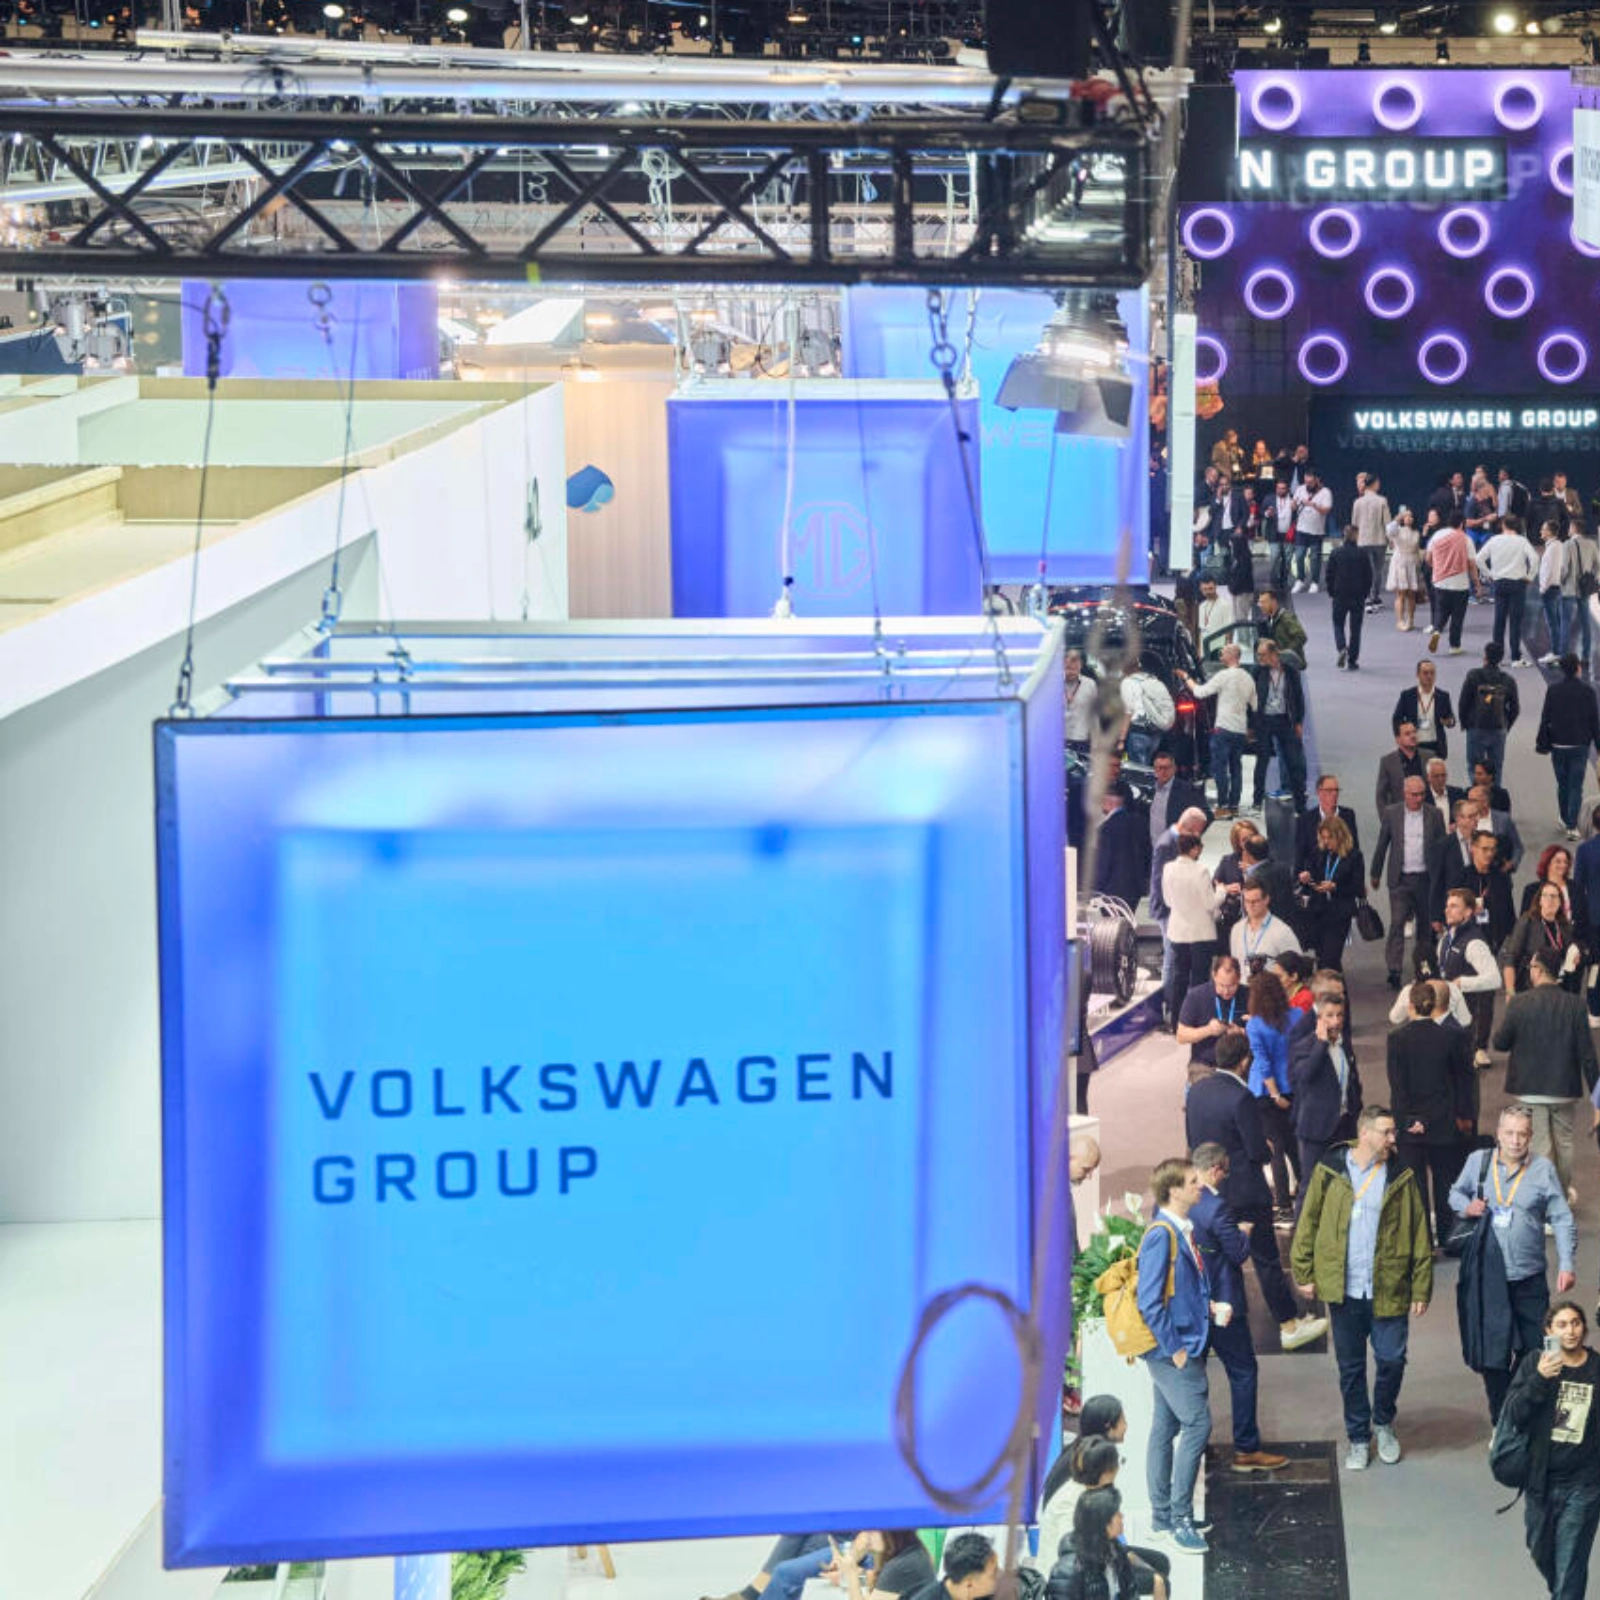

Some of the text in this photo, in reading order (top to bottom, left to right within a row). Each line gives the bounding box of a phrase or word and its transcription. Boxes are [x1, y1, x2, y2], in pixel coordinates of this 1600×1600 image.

[1305, 148, 1495, 189] GROUP
[1354, 411, 1511, 429] VOLKSWAGEN
[1522, 409, 1598, 428] GROUP
[307, 1050, 894, 1121] VOLKSWAGEN
[313, 1146, 599, 1205] GROUP
